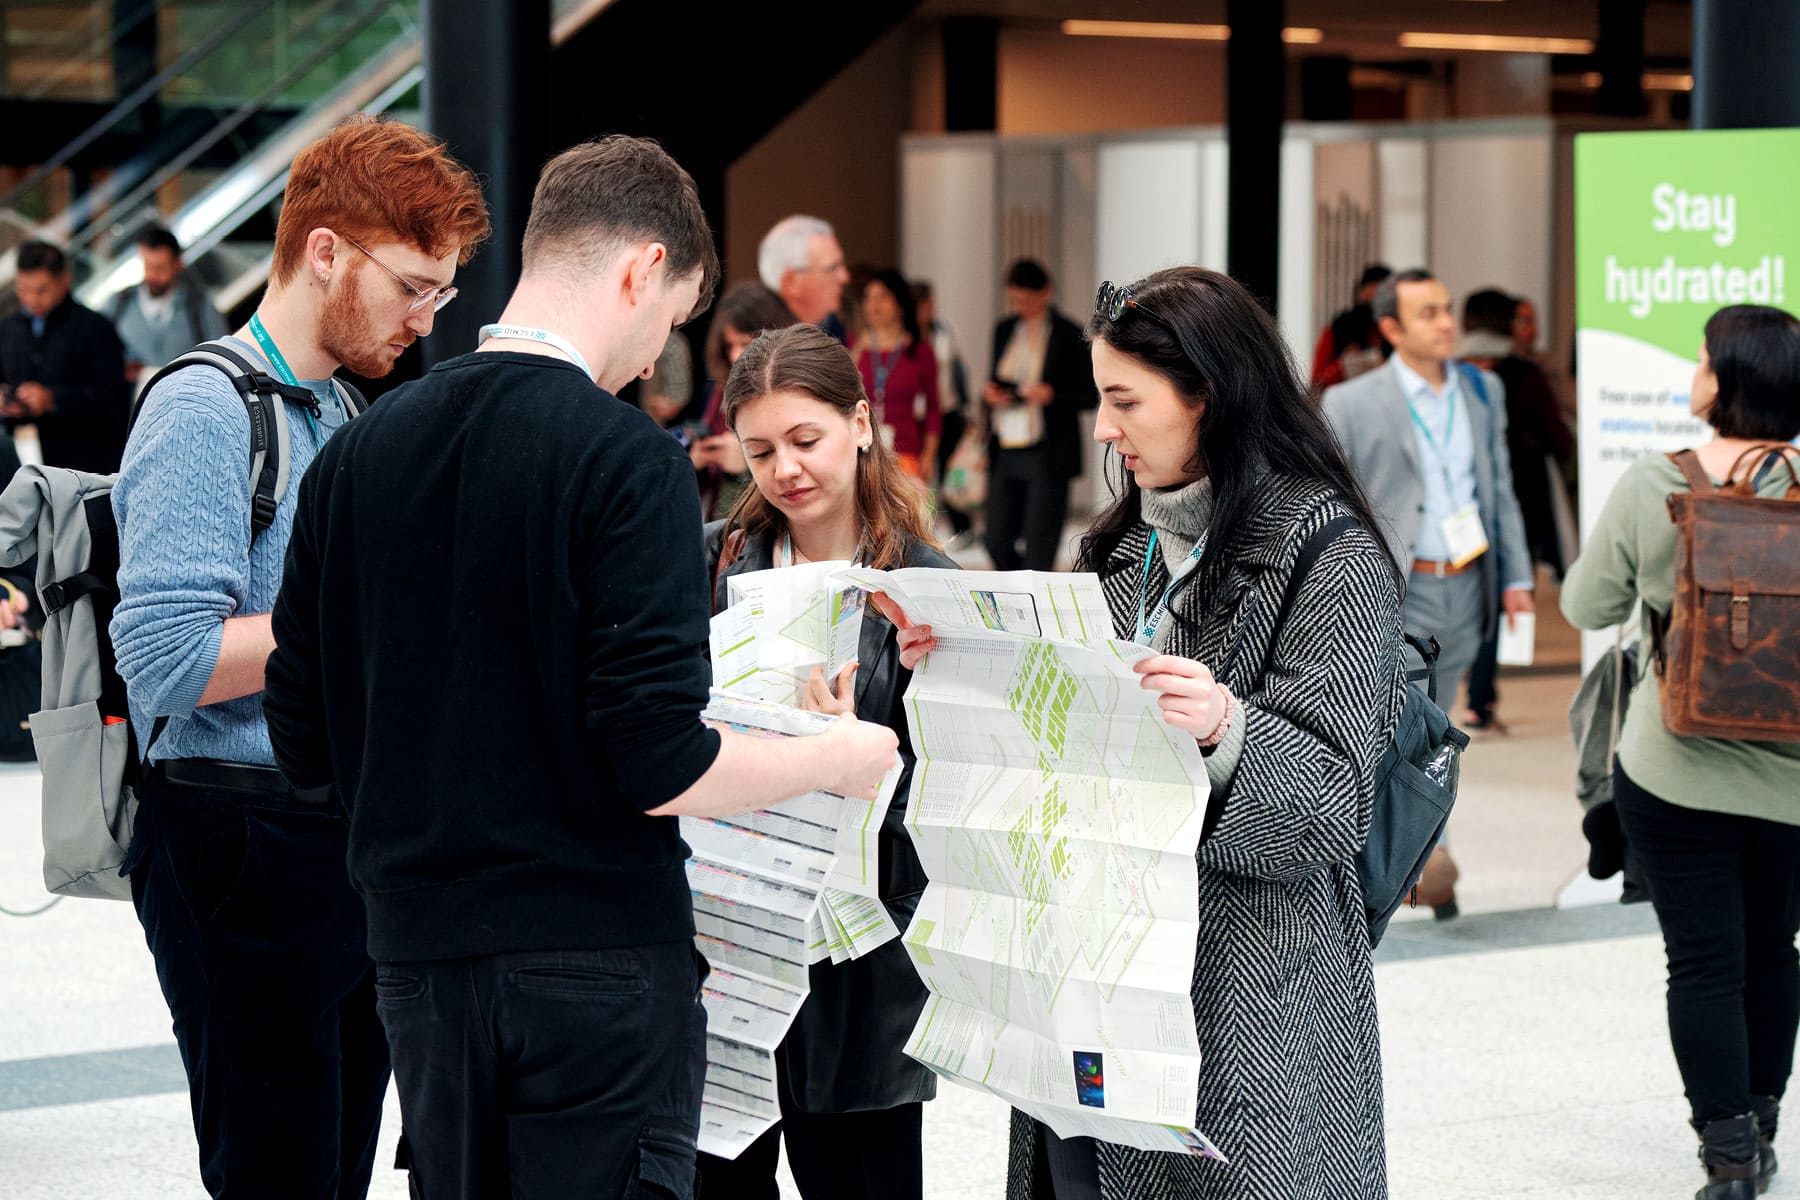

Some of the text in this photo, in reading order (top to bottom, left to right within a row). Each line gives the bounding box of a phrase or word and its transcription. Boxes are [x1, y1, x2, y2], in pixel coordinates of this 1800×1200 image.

[1651, 183, 1736, 247] Stay
[1605, 255, 1784, 318] hydrated!
[1150, 602, 1168, 628] ESCMID
